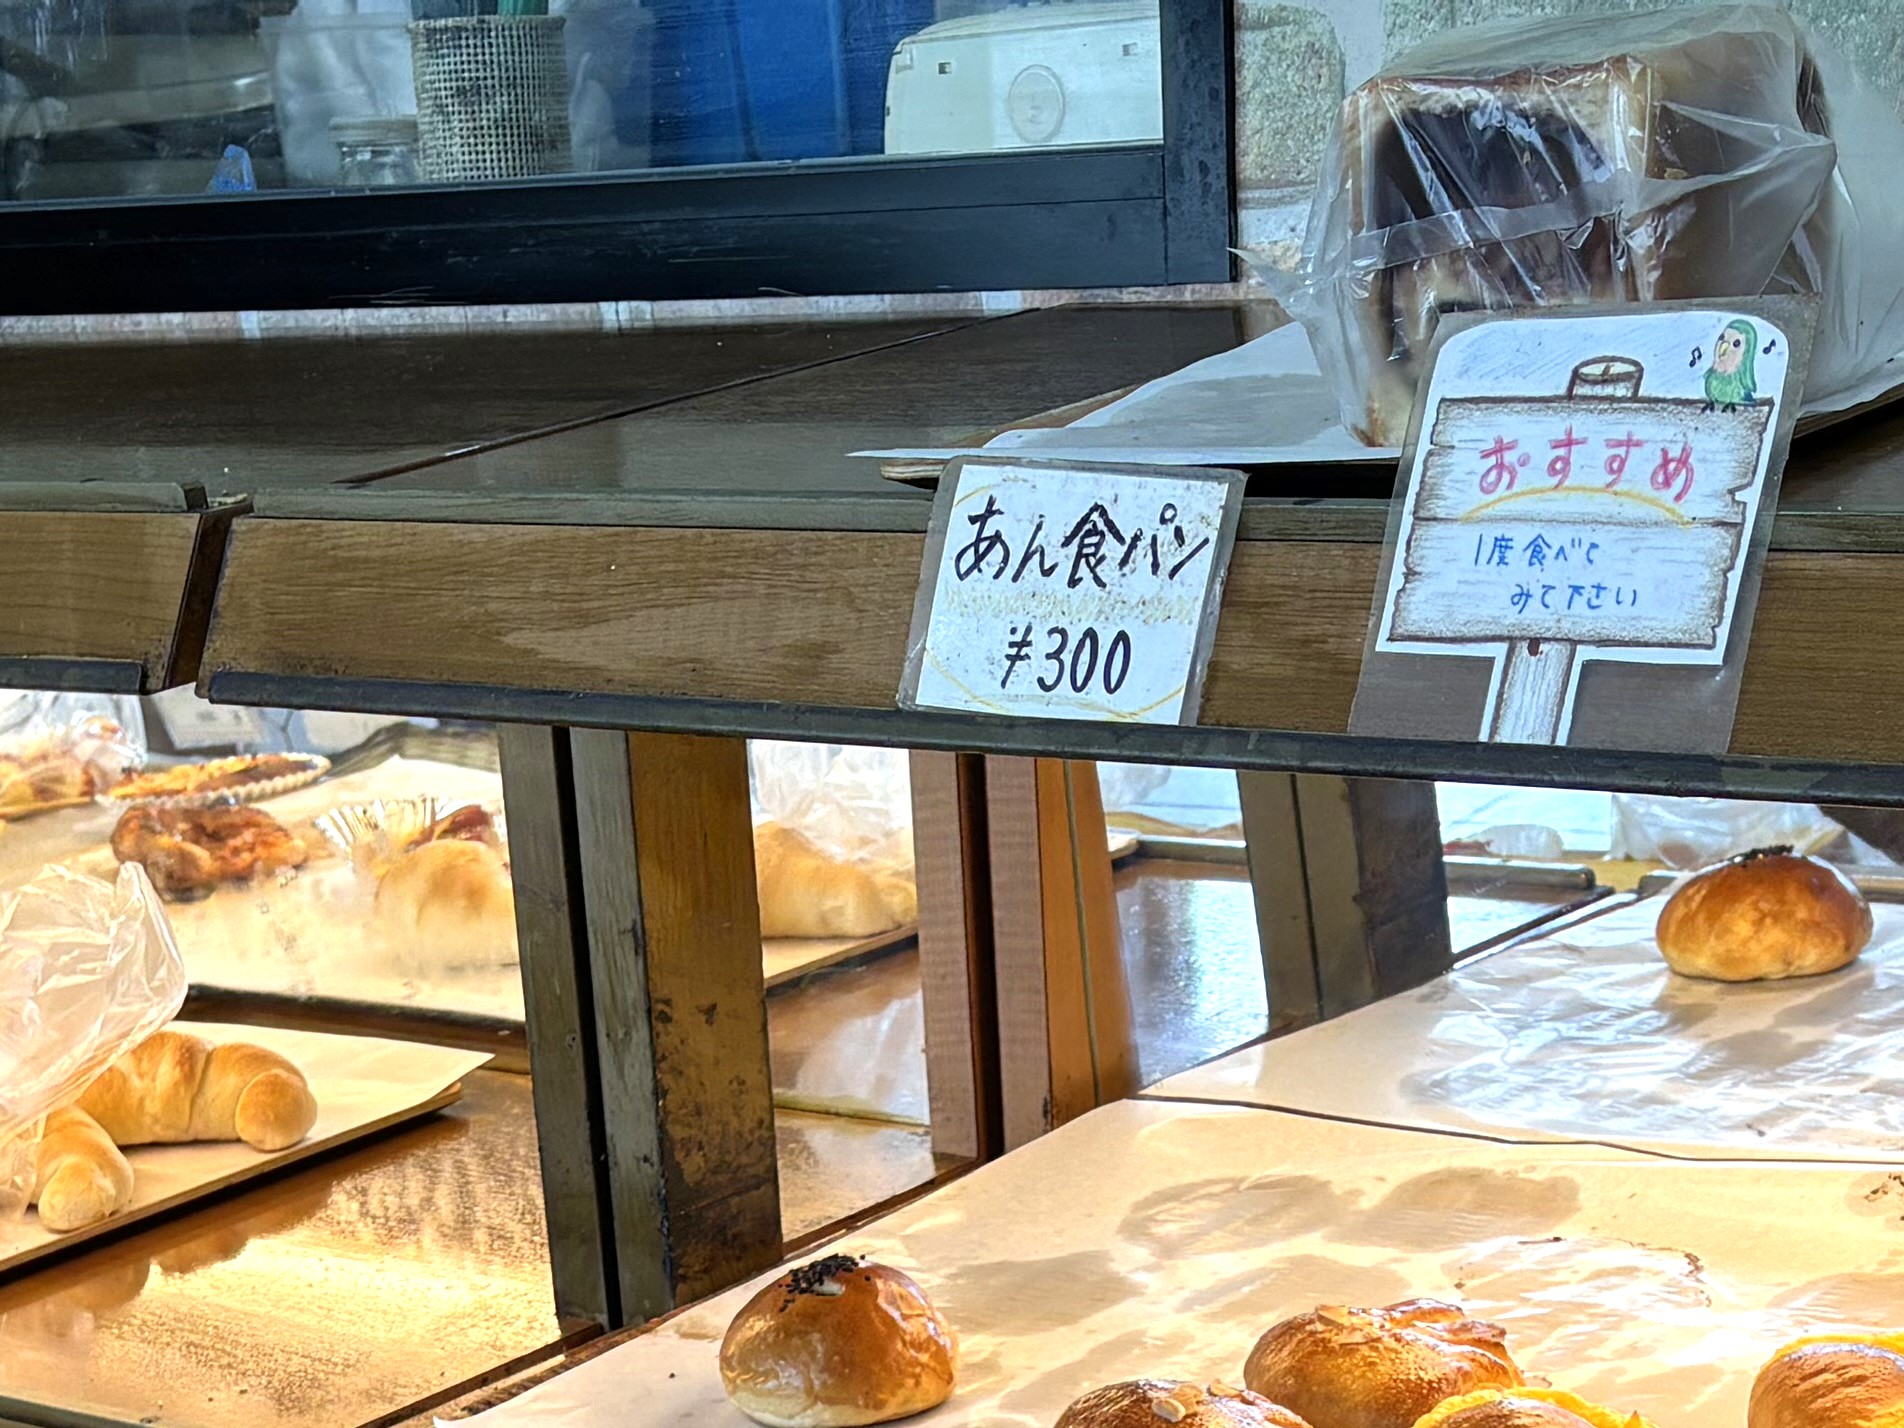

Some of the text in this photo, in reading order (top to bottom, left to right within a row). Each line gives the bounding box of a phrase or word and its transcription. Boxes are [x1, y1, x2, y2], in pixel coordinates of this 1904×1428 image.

[1478, 423, 1694, 504] おすすめ
[954, 494, 1210, 589] あん食パン
[1510, 582, 1638, 614] みて下さい
